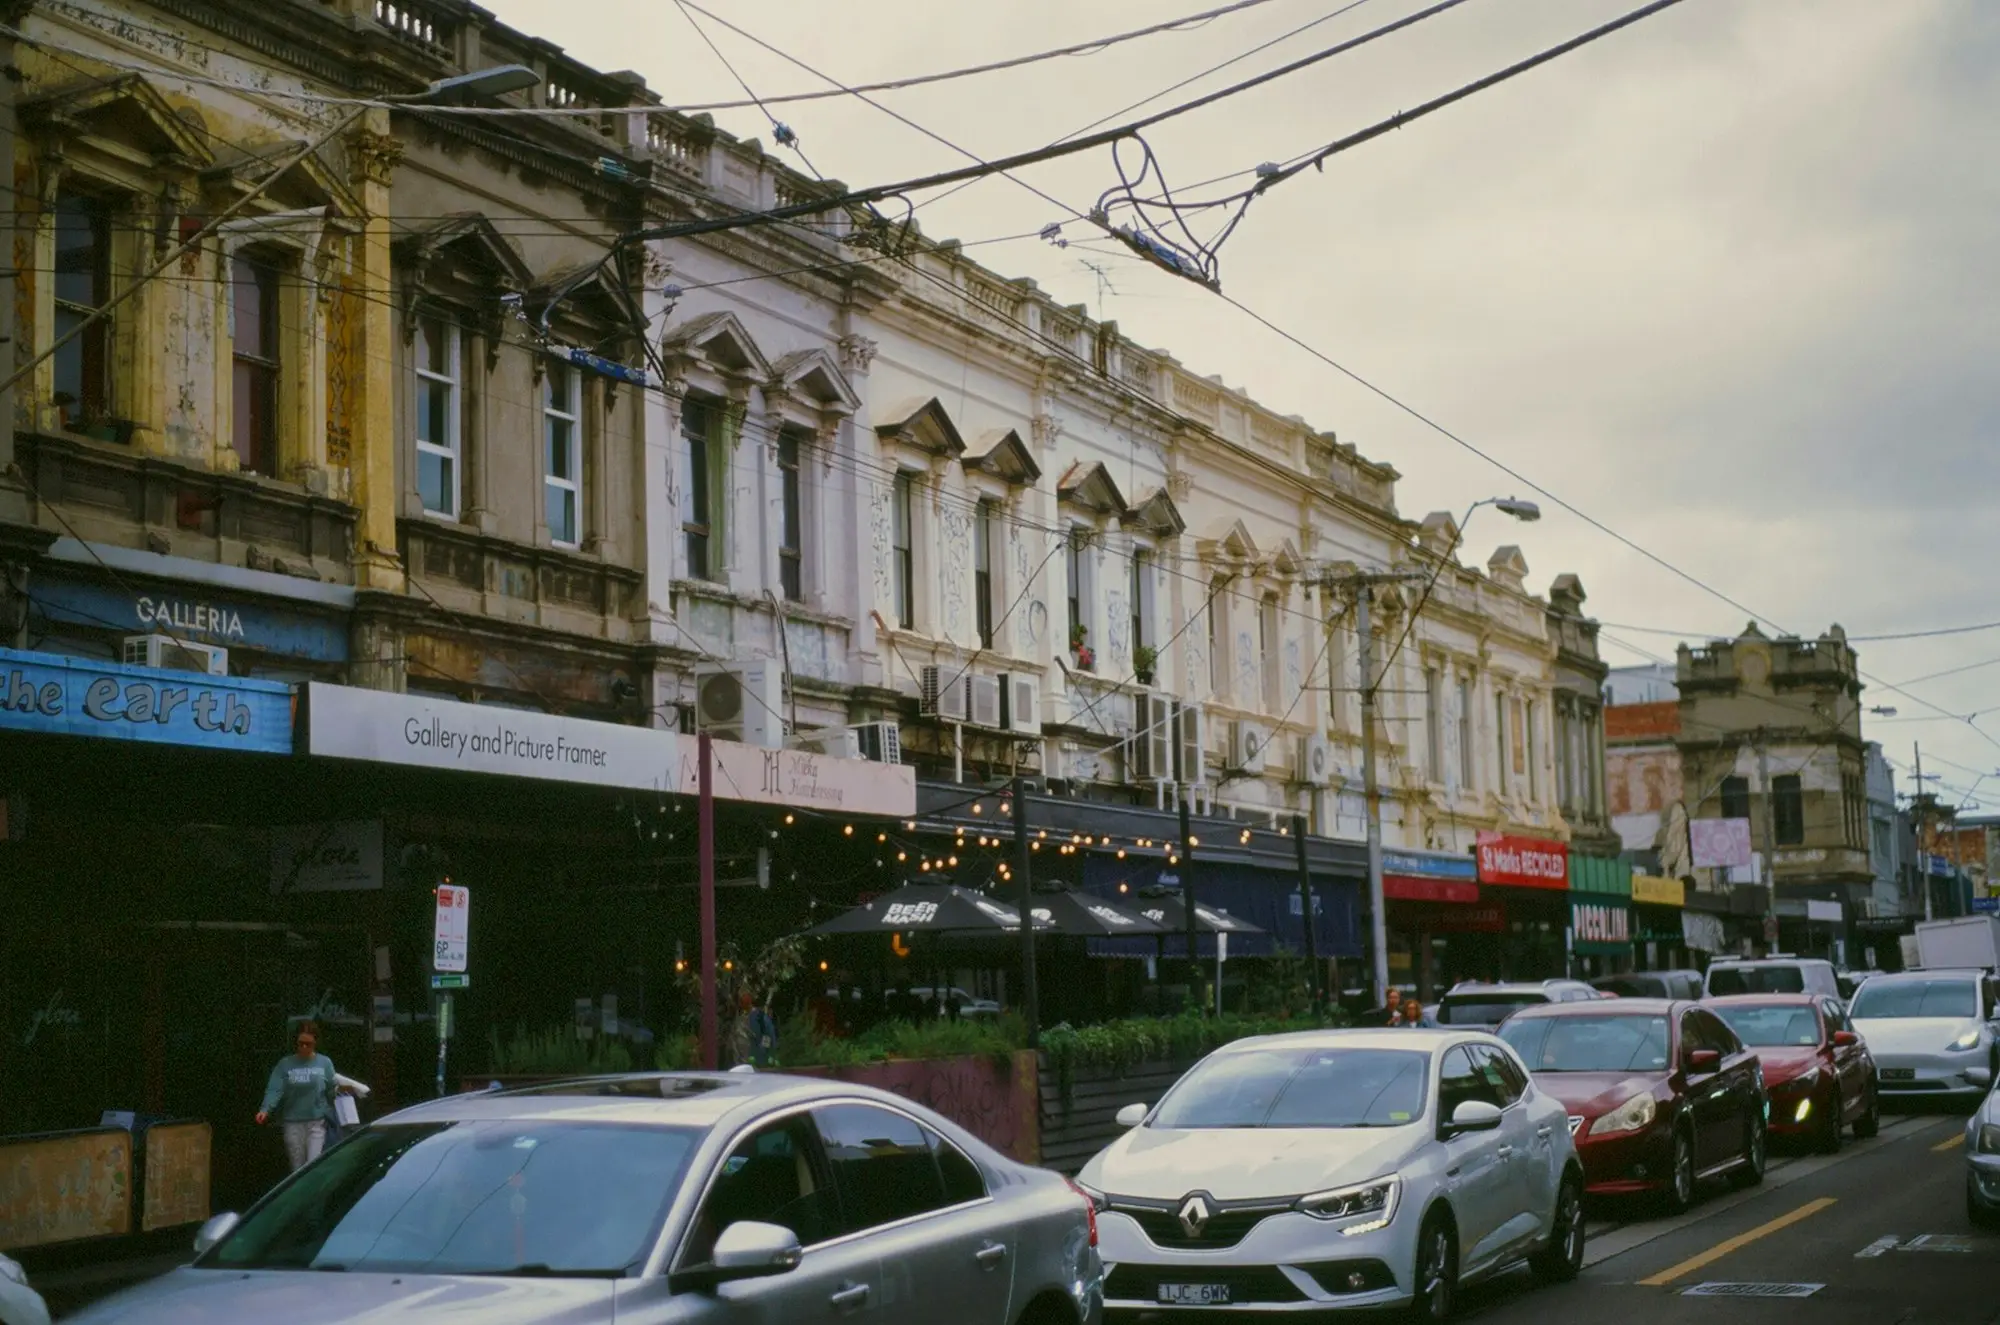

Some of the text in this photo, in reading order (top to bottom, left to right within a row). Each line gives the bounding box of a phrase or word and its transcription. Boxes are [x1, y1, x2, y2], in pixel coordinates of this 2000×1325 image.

[136, 596, 244, 636] GALLERIA
[83, 677, 250, 735] earth
[404, 717, 468, 758] Gallery
[471, 725, 501, 754] and
[504, 730, 554, 760] Picture
[1521, 850, 1565, 879] RECYCLED
[881, 912, 935, 925] MASH
[887, 901, 939, 915] BEER
